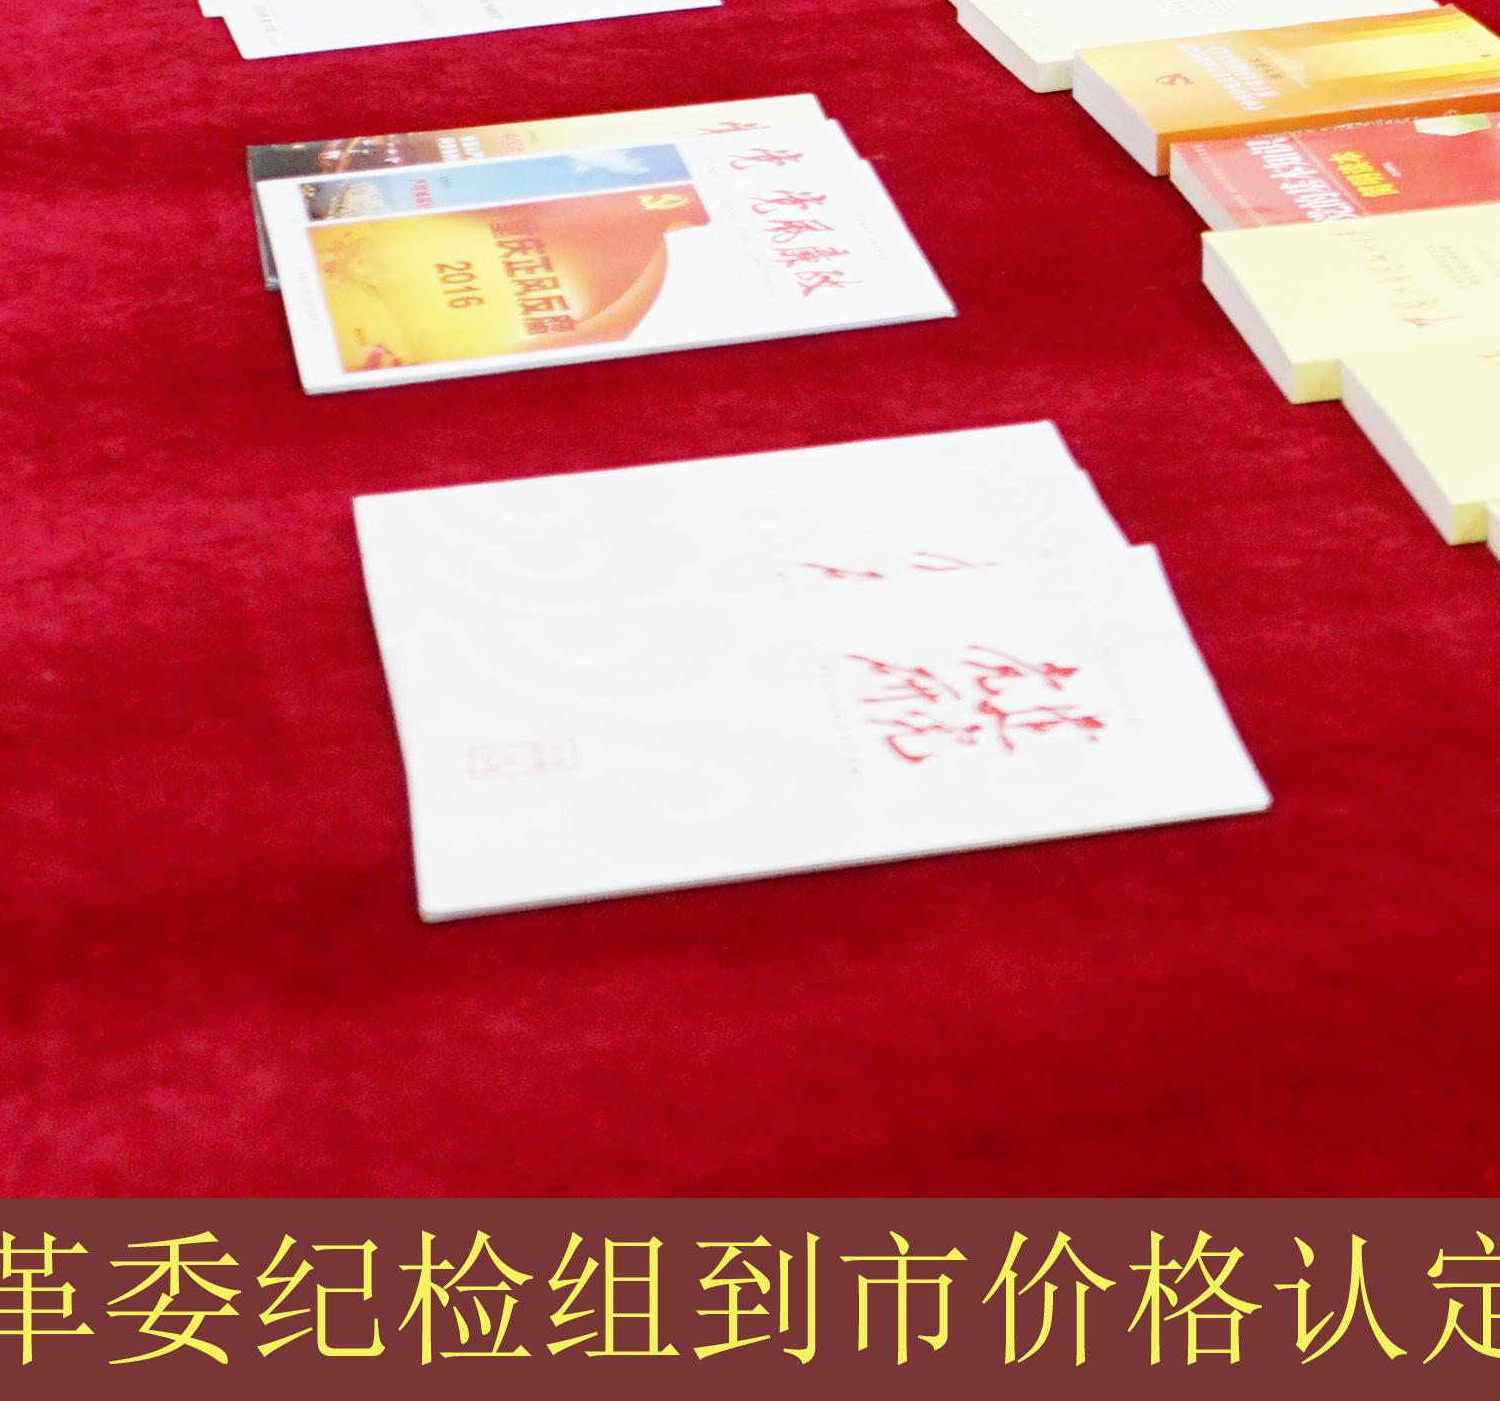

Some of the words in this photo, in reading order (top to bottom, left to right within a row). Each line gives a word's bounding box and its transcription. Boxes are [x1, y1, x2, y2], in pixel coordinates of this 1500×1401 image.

[1324, 149, 1402, 198] 简明读本
[431, 259, 489, 311] 2016
[484, 217, 582, 337] 重庆正风反腐
[738, 185, 885, 302] 党风廉政
